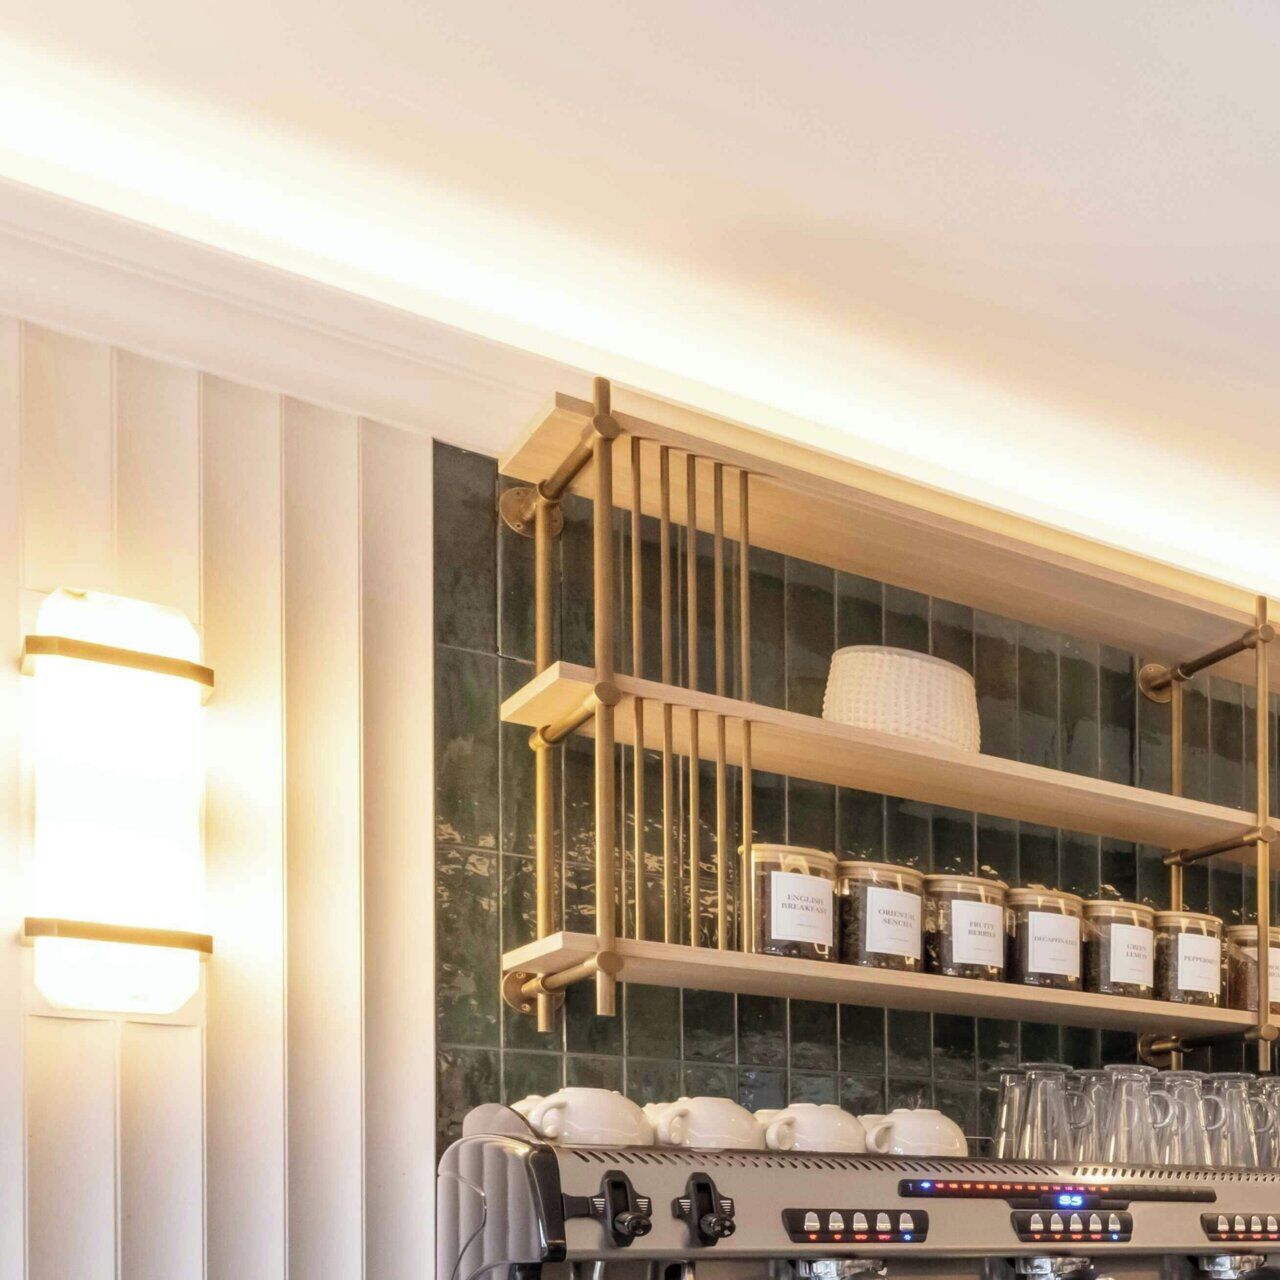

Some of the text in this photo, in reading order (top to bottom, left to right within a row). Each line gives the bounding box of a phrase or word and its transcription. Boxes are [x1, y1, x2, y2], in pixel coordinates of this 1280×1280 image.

[786, 893, 824, 906] ENGLISH
[781, 902, 828, 915] BREAKFAST
[878, 908, 916, 920] ORIENTAL
[882, 917, 914, 929] SENCHA
[969, 921, 995, 930] FRUITY
[967, 929, 997, 938] BERRIES
